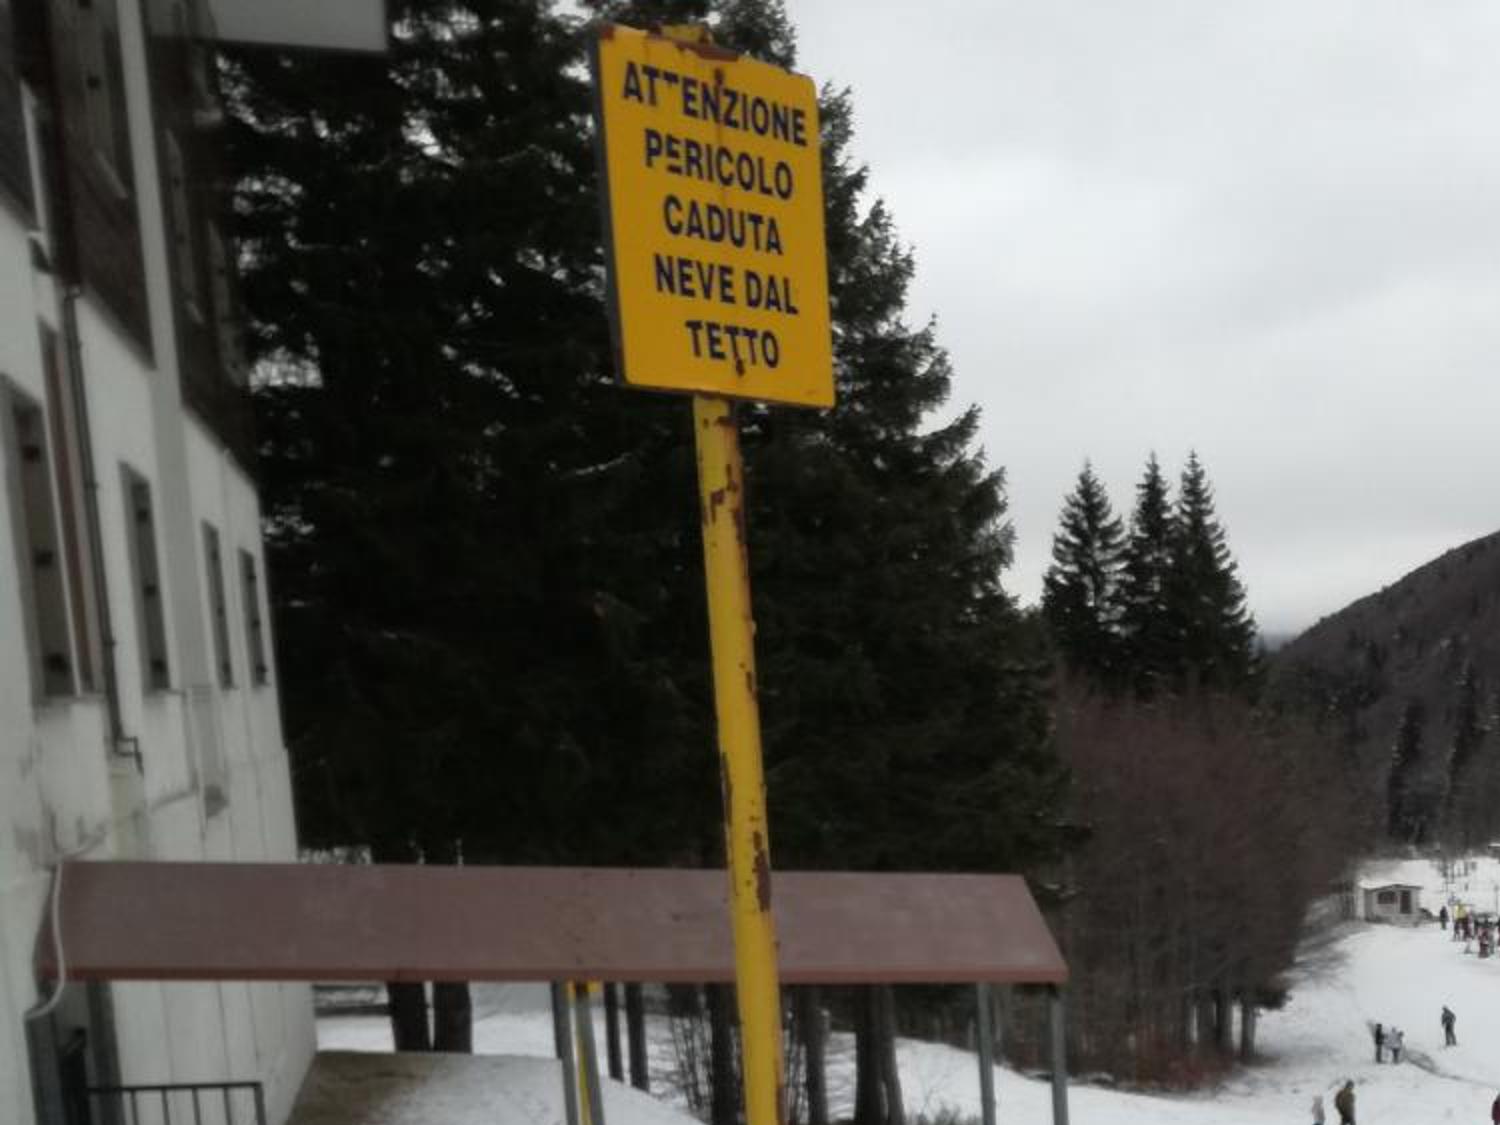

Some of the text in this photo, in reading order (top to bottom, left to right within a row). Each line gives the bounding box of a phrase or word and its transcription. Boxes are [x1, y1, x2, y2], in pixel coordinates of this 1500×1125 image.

[644, 128, 794, 201] PERICOLO
[662, 194, 784, 256] CADUTA
[654, 253, 799, 316] NEVE DAL
[685, 319, 780, 369] TETTO
